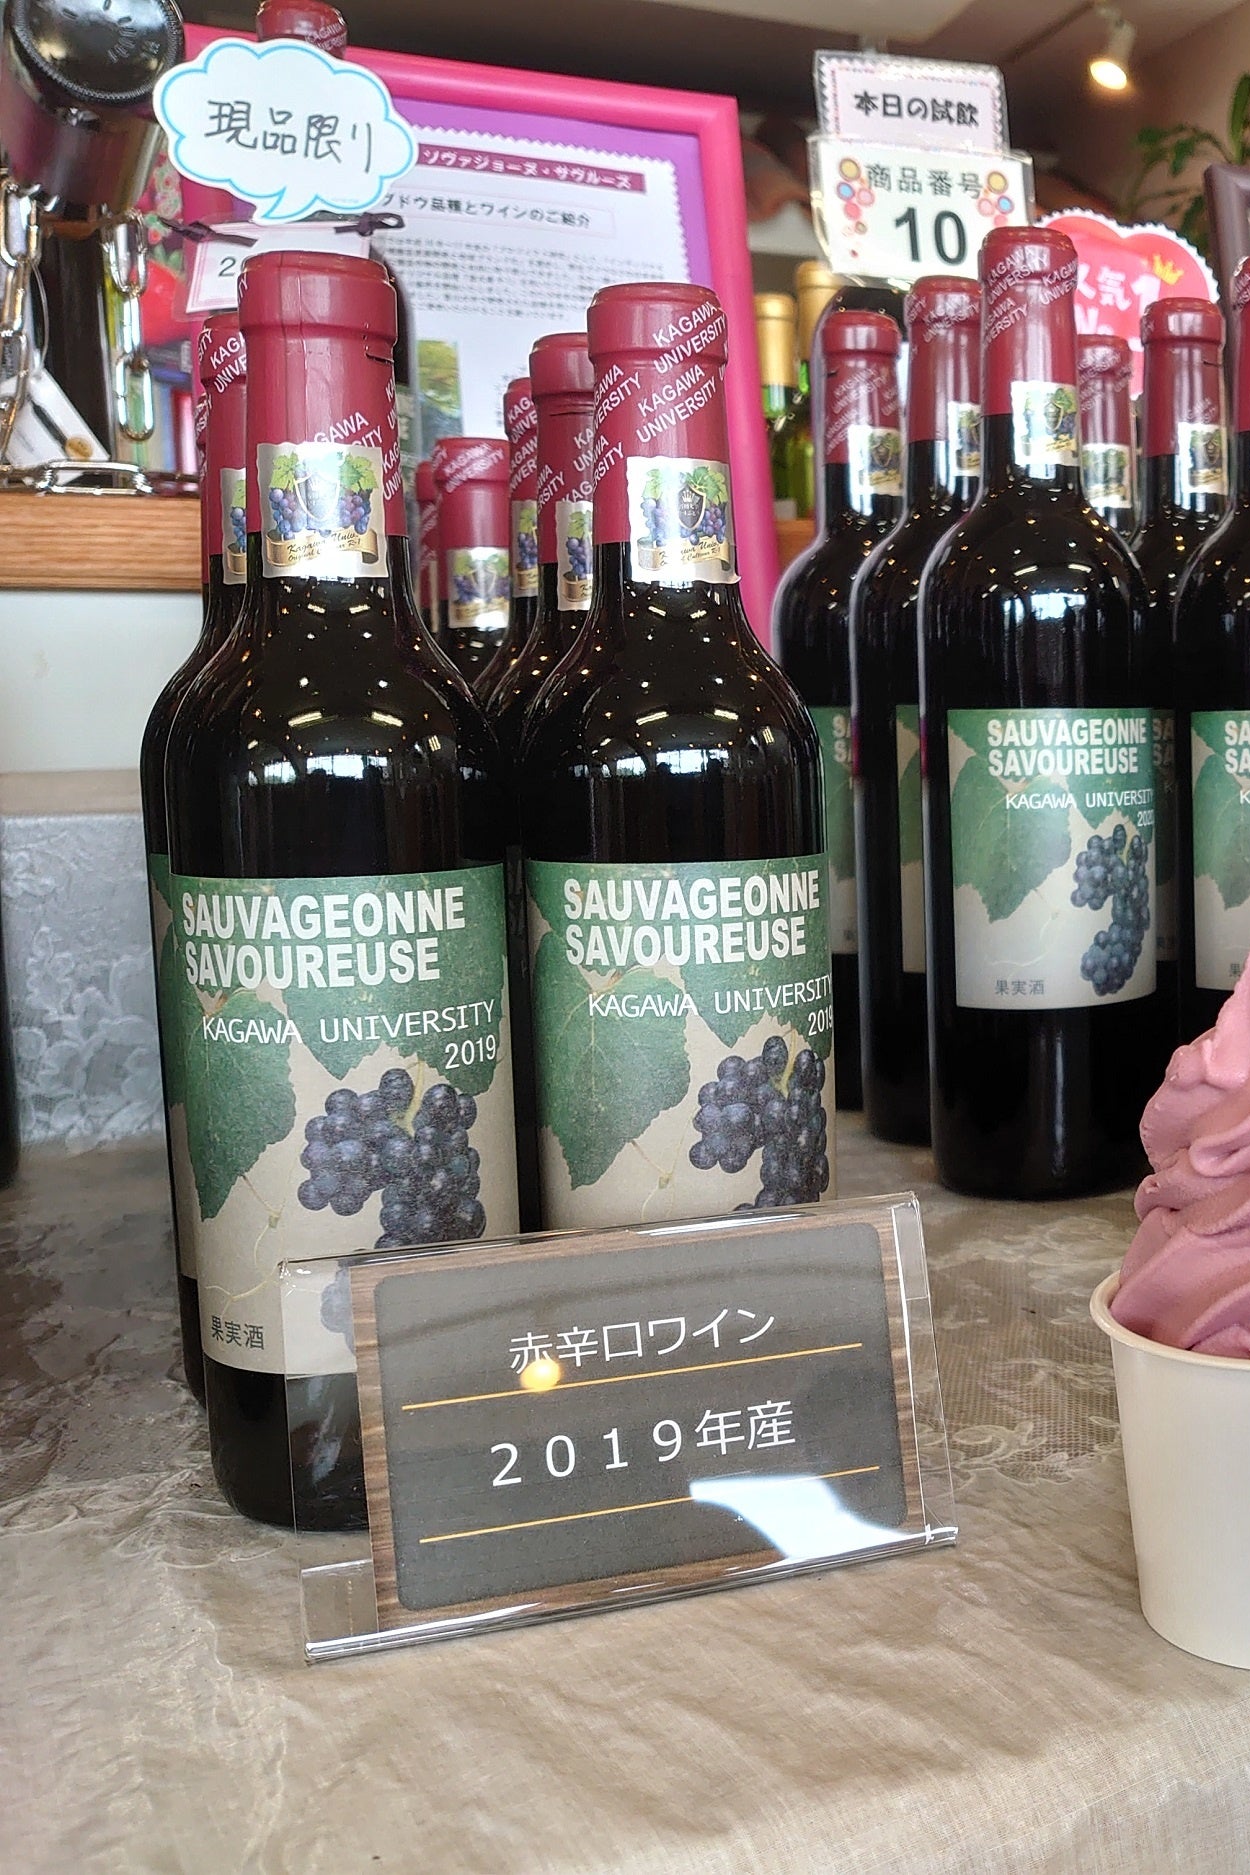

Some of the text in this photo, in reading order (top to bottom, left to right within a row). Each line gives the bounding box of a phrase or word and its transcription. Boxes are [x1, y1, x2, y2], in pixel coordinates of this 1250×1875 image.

[853, 90, 980, 127] 本日の試飲
[205, 101, 372, 174] 現品限り
[865, 163, 985, 199] 商品番号
[894, 207, 967, 266] 10
[652, 301, 717, 347] KAGAWA
[653, 314, 727, 375] UNIVERSITY
[636, 377, 717, 443] UNIVERSITY
[638, 364, 705, 417] KAGAWA
[987, 717, 1147, 748] SAUVAGEONNE
[988, 747, 1138, 778] SAVOUREUSE
[1005, 793, 1077, 810] KAGAWA
[182, 886, 466, 940] SAUVAGEONNE
[563, 869, 820, 921] SAUVAGEONNE
[185, 937, 441, 989] SAVOUREUSE
[565, 916, 806, 967] SAVOUREUSE
[589, 994, 698, 1018] KAGAWA
[995, 979, 1045, 997] 果実酒
[203, 999, 496, 1044] KAGAWA UNIVERSITY
[445, 1034, 496, 1070] 2019
[211, 1315, 265, 1350] 果実酒
[509, 1307, 776, 1376] 赤辛口ワイン
[490, 1398, 798, 1488] 2019年産
